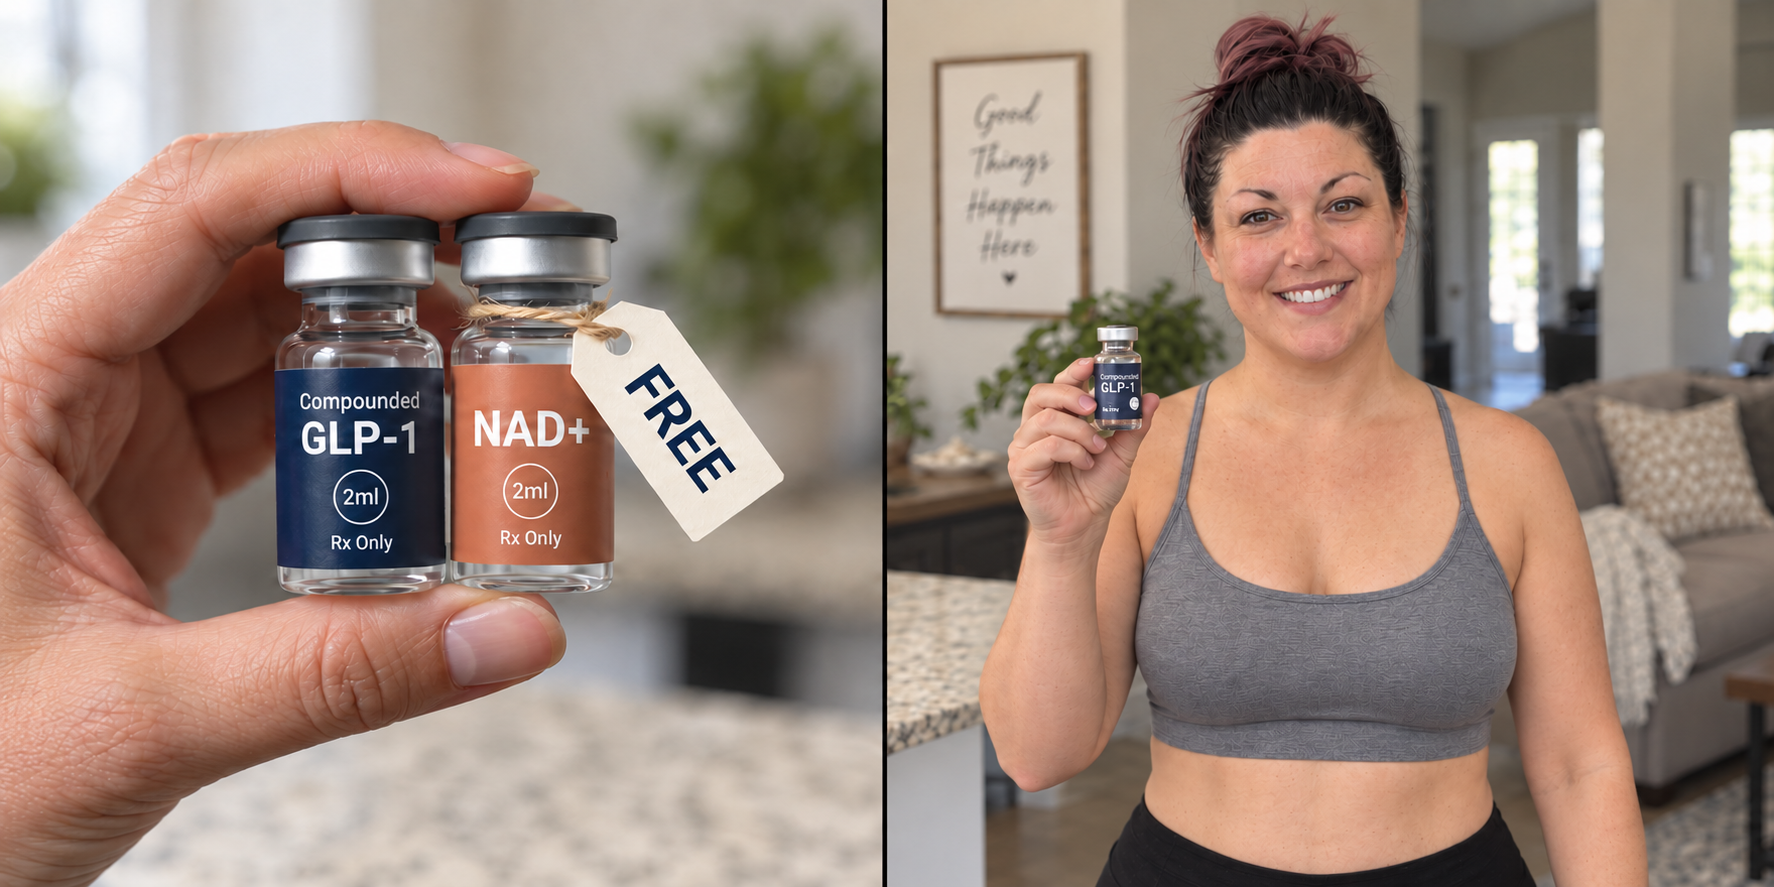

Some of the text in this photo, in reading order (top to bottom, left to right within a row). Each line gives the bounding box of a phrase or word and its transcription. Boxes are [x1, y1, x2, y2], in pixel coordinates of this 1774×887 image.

[974, 90, 1041, 139] Good
[970, 142, 1051, 186] Things
[967, 188, 1056, 226] Happen
[980, 229, 1038, 263] Here
[299, 391, 420, 414] Compounded
[1101, 382, 1135, 393] GLP-1
[301, 420, 416, 455] GLP-1
[474, 410, 590, 447] NAD+
[624, 363, 736, 494] FREE
[342, 487, 379, 505] 2ml
[512, 482, 548, 499] 2ml
[331, 534, 393, 553] Rx Only
[500, 530, 562, 549] Rx Only
